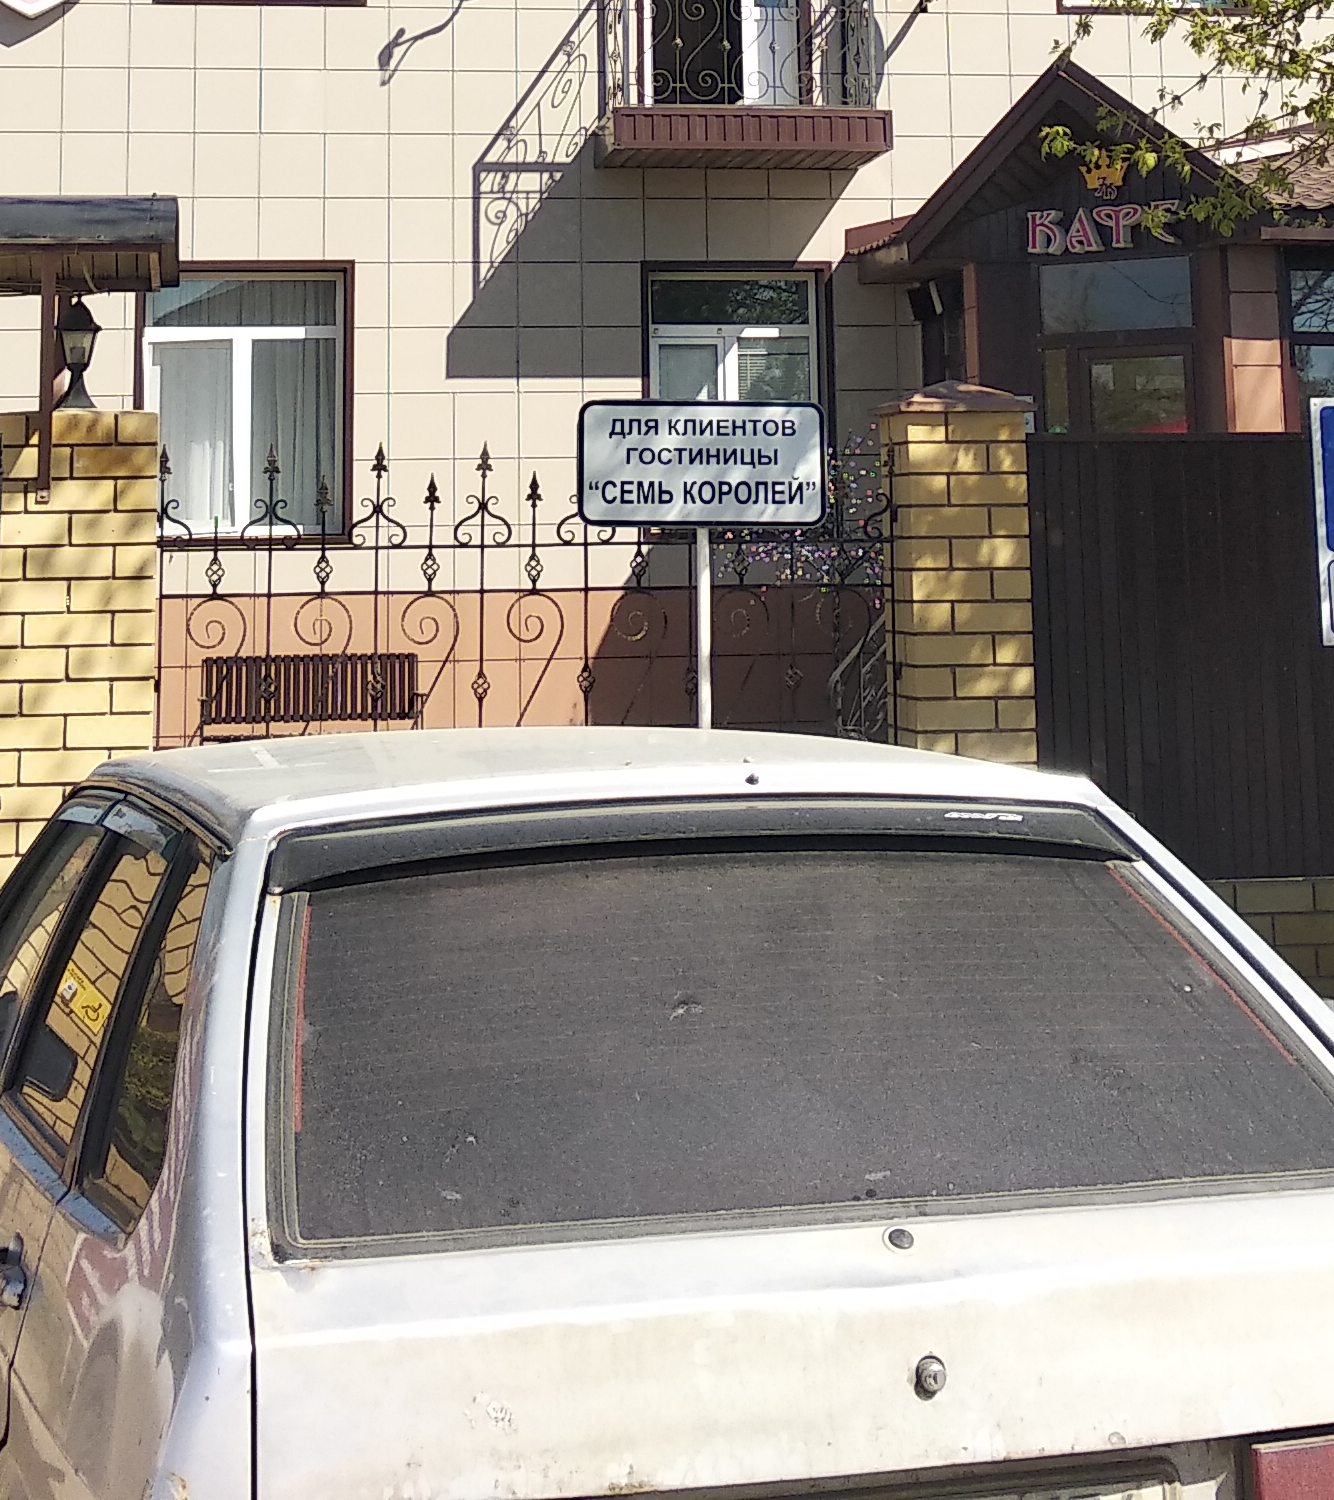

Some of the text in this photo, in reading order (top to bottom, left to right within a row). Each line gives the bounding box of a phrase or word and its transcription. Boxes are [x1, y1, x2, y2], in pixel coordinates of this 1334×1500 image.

[609, 418, 798, 439] ДЛЯ КЛИЕНТОВ
[625, 447, 779, 469] ГОСТИНИЦЫ
